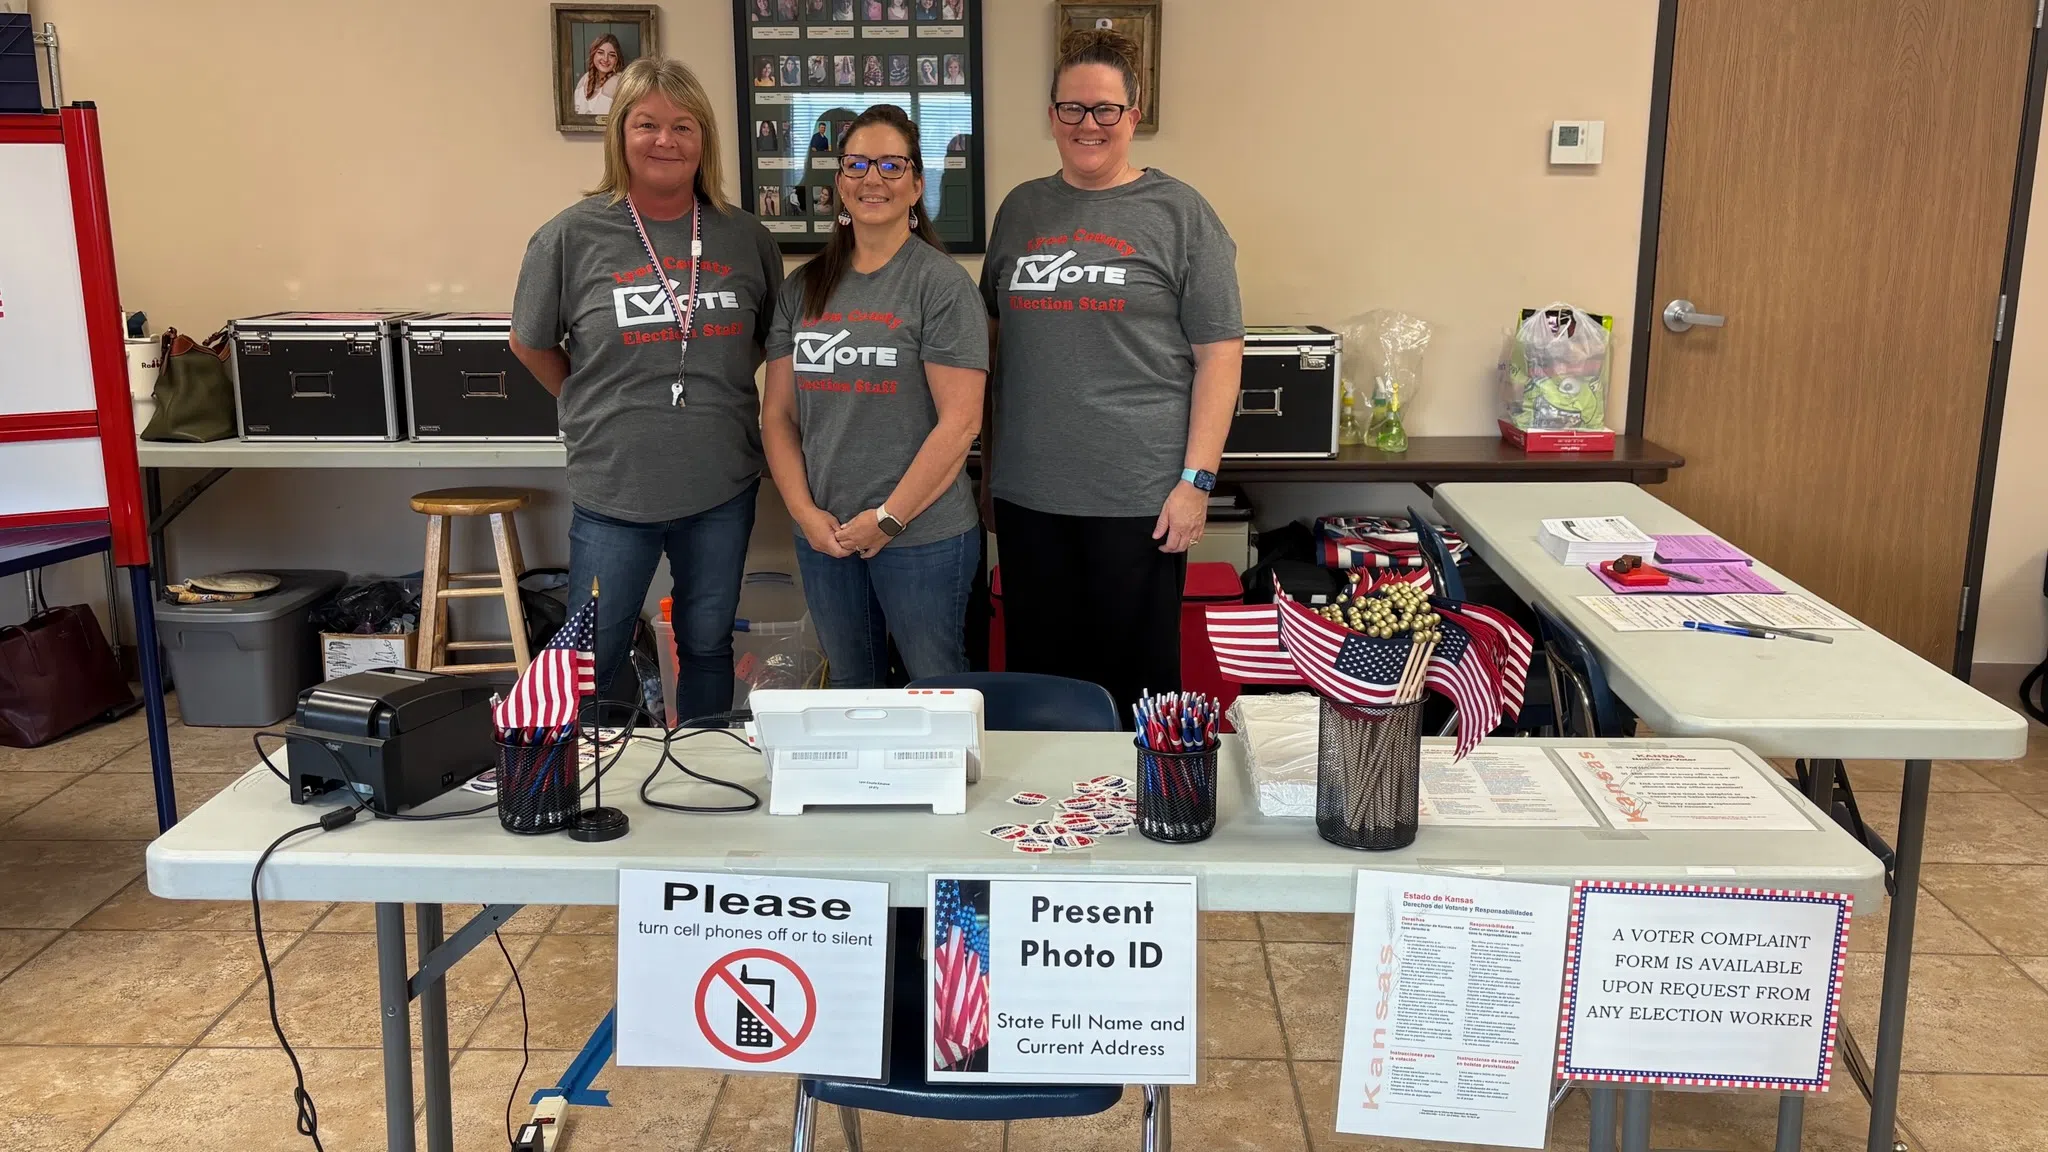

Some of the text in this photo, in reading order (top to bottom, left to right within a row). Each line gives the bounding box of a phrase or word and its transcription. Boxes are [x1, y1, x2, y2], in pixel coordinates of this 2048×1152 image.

[1073, 228, 1136, 257] County
[611, 263, 653, 284] Lyon
[1011, 249, 1126, 290] VOTE
[1079, 296, 1127, 312] Staff
[848, 309, 903, 329] County
[795, 329, 897, 371] VOTE
[855, 379, 897, 394] Staff
[664, 882, 852, 920] Please
[1403, 901, 1432, 909] Derechos
[1445, 904, 1468, 912] Votante
[1475, 907, 1533, 916] Responsabilidades
[1404, 892, 1431, 901] Estado
[1445, 895, 1474, 904] Kansas
[1031, 896, 1154, 924] Present
[638, 921, 873, 947] turn cell phones off or to silent
[1612, 929, 1811, 949] A VOTER COMPLAINT
[1021, 940, 1163, 969] Photo ID
[1615, 954, 1803, 975] FORM IS AVAILABLE
[1602, 979, 1811, 1001] UPON REQUEST FROM
[997, 1012, 1185, 1032] State Full Name and
[1362, 944, 1393, 1109] Kansas
[1586, 1005, 1813, 1027] ANY ELECTION WORKER
[1016, 1037, 1165, 1056] Current Address
